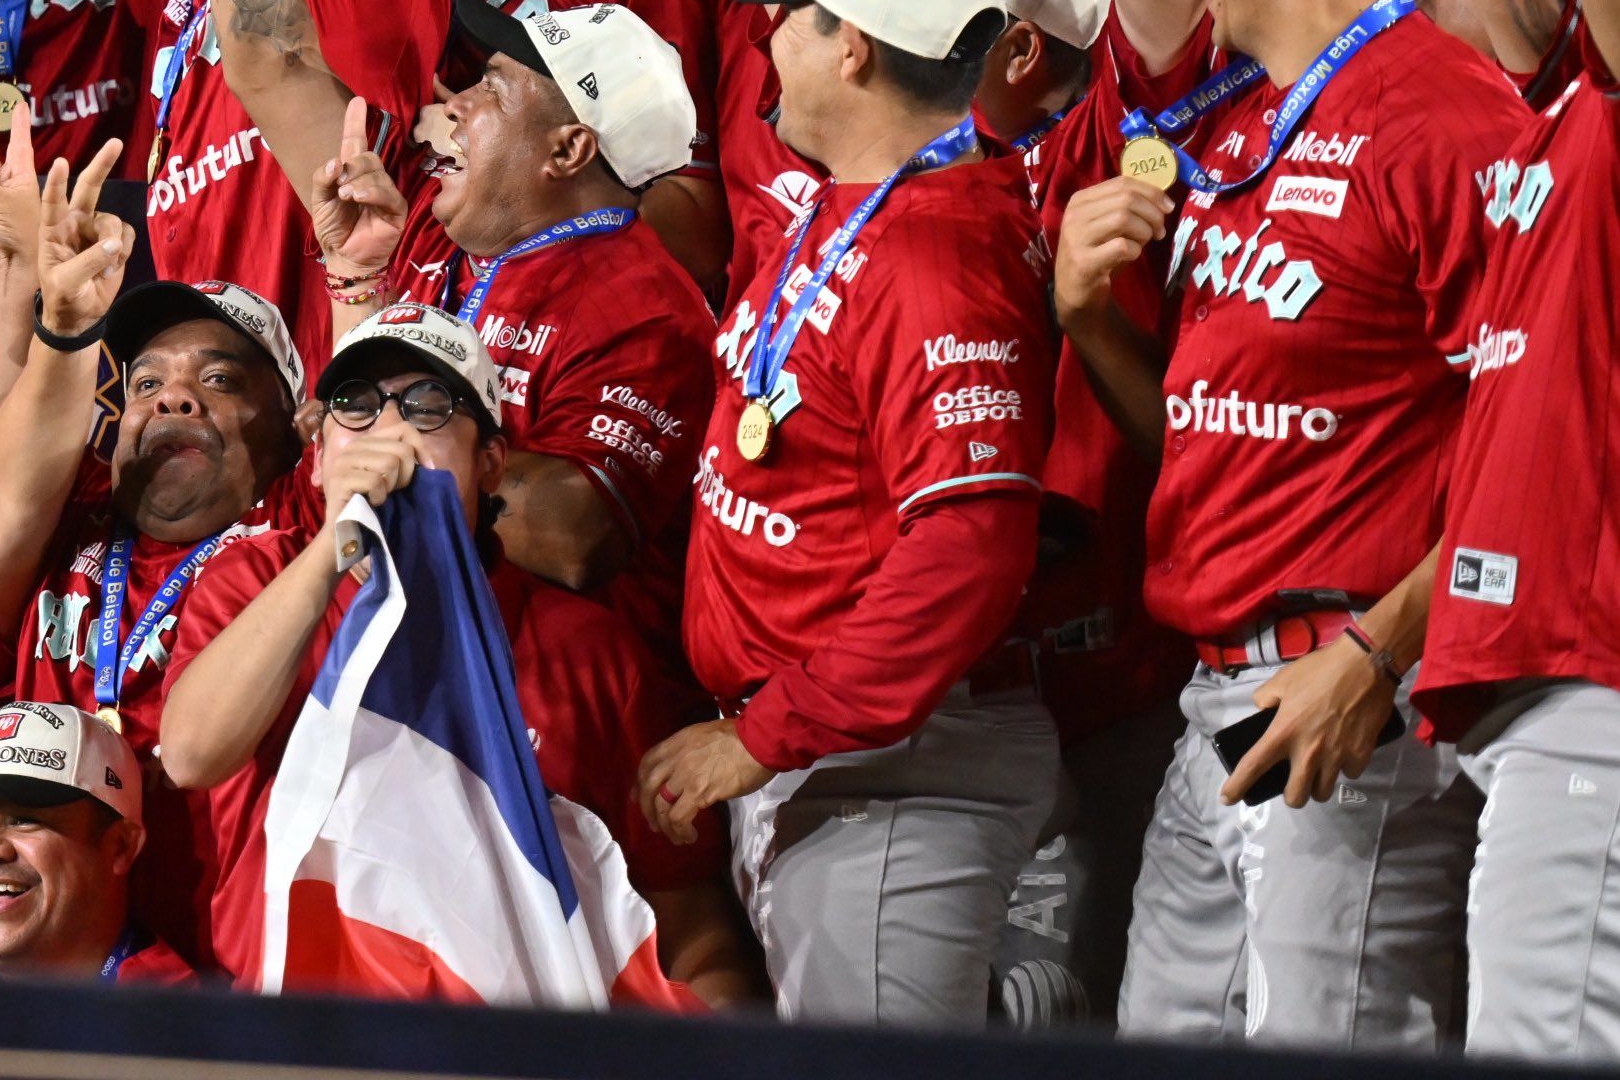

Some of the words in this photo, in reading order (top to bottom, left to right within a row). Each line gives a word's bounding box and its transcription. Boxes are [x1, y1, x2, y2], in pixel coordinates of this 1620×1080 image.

[1328, 24, 1368, 61] Liga
[1160, 107, 1193, 128] Liga
[1193, 58, 1264, 112] Mexican
[1271, 58, 1333, 141] Mexicana
[1129, 154, 1169, 177] 2024
[1283, 130, 1367, 167] Mobil
[147, 126, 272, 218] ofutur
[1275, 184, 1337, 206] Lenovo
[551, 222, 573, 236] de
[572, 209, 626, 230] Beisbol
[810, 249, 841, 288] Liga
[837, 175, 894, 246] Mexican
[788, 269, 832, 322] Levo
[372, 326, 467, 362] PEONES
[479, 313, 552, 356] Mobil
[924, 333, 1020, 371] Kleenex
[600, 384, 684, 439] Kleenex
[933, 385, 1021, 412] Office
[934, 405, 1023, 429] DEPOT
[1166, 379, 1338, 442] ofuturo
[590, 413, 665, 465] Office
[741, 423, 764, 441] 2024
[583, 430, 660, 476] DEPOT
[693, 445, 797, 548] futuro
[109, 557, 126, 578] de
[1483, 578, 1506, 589] ERA
[1484, 567, 1507, 580] NEW
[162, 578, 183, 598] de
[102, 581, 123, 647] Beisbol
[119, 599, 168, 662] Beisbol
